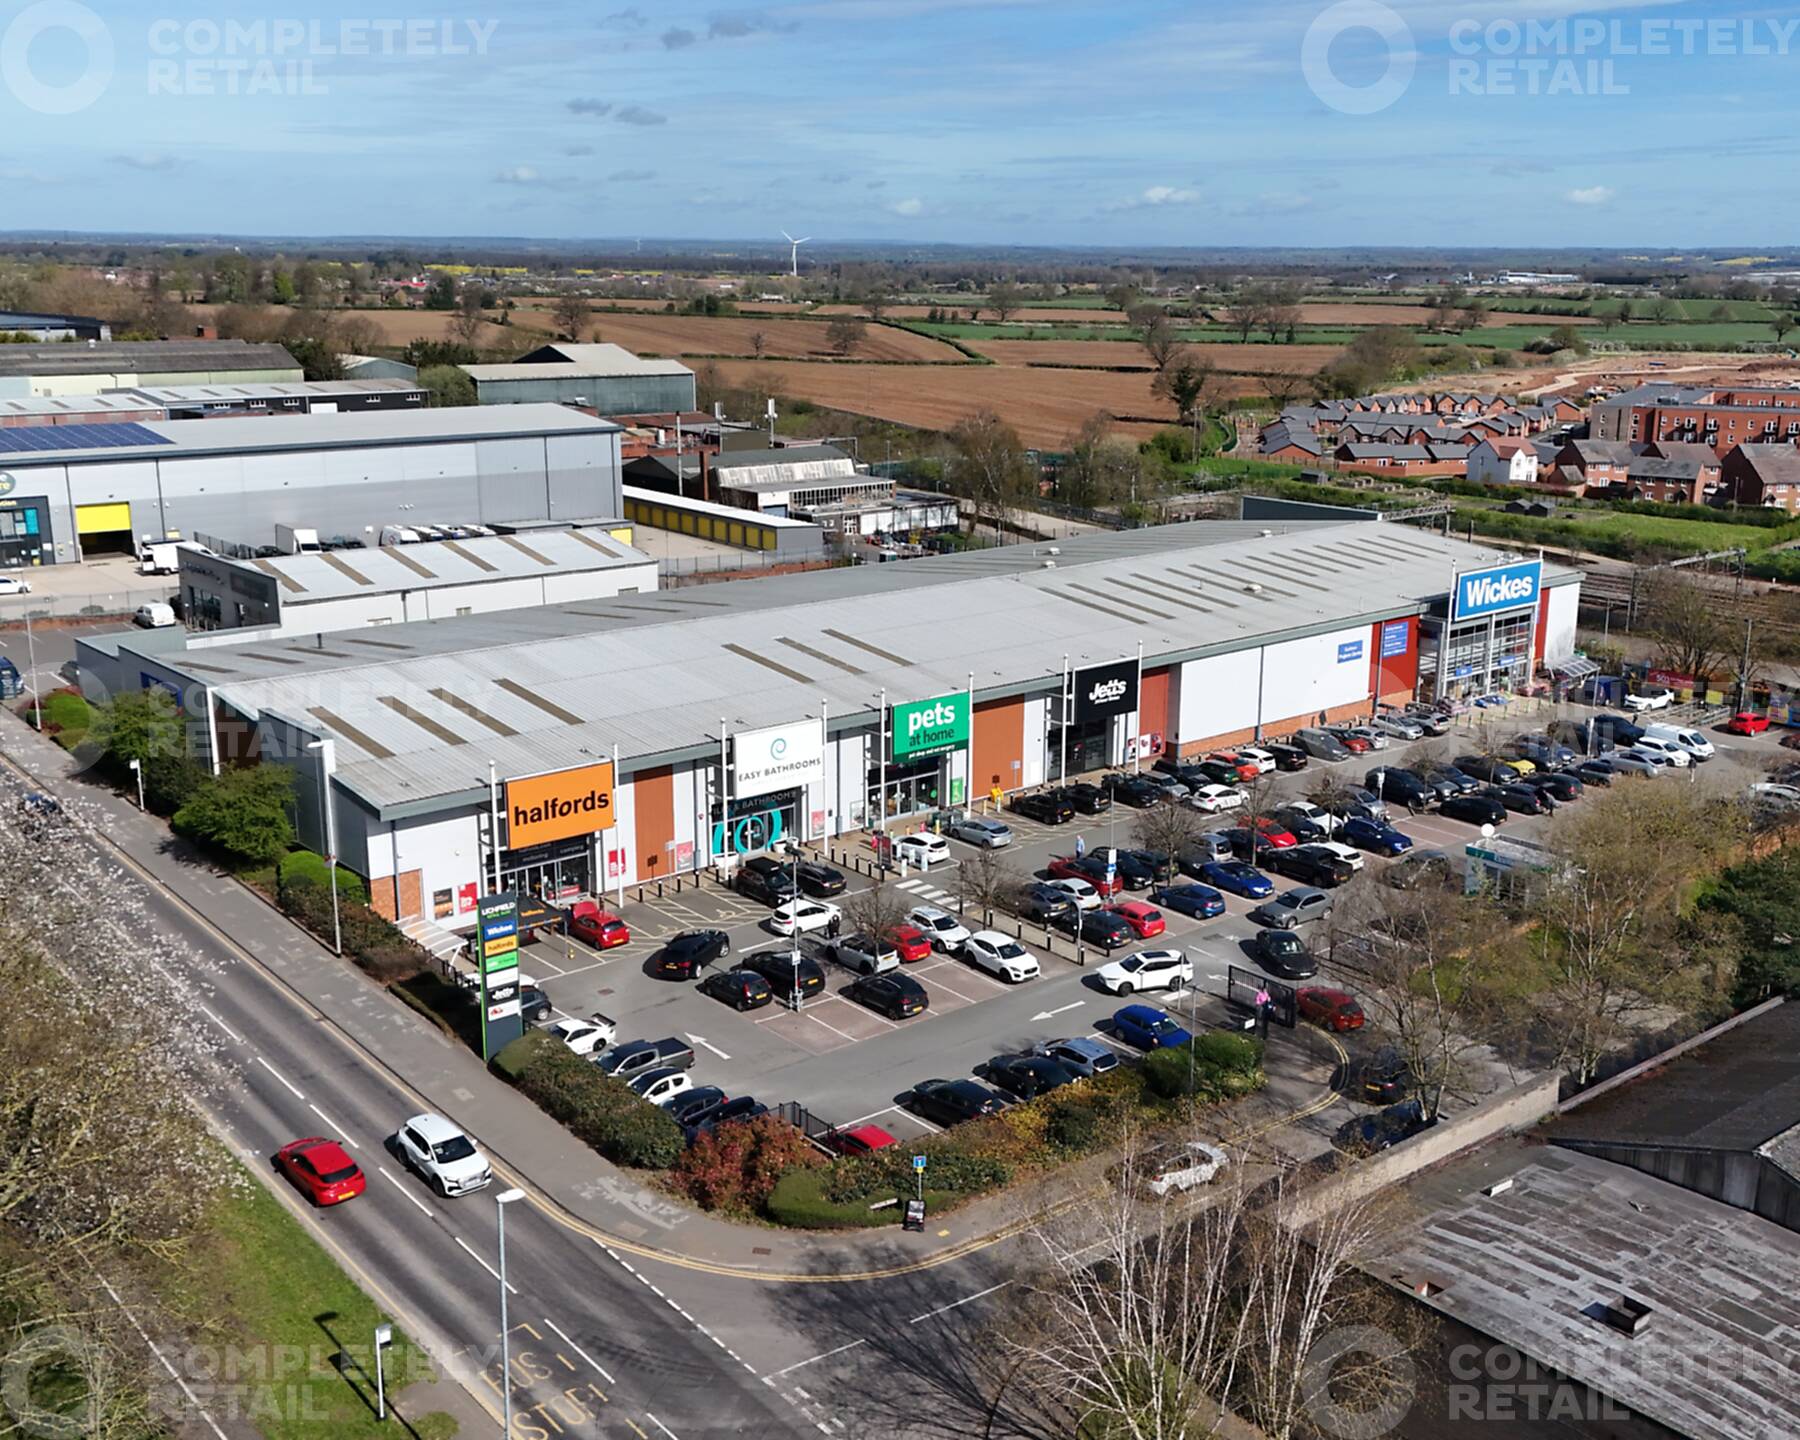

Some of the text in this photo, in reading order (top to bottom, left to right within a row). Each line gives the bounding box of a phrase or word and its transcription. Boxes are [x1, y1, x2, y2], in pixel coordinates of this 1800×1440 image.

[1466, 574, 1534, 608] Wickes
[1089, 678, 1127, 701] Jetts
[908, 702, 955, 736] pets
[909, 728, 955, 747] at home
[738, 769, 762, 782] EASY
[763, 757, 822, 777] BATHROOMS
[514, 790, 610, 827] halfords
[488, 940, 515, 952] halfords
[479, 1351, 553, 1398] BUS
[512, 1387, 596, 1440] STOP
